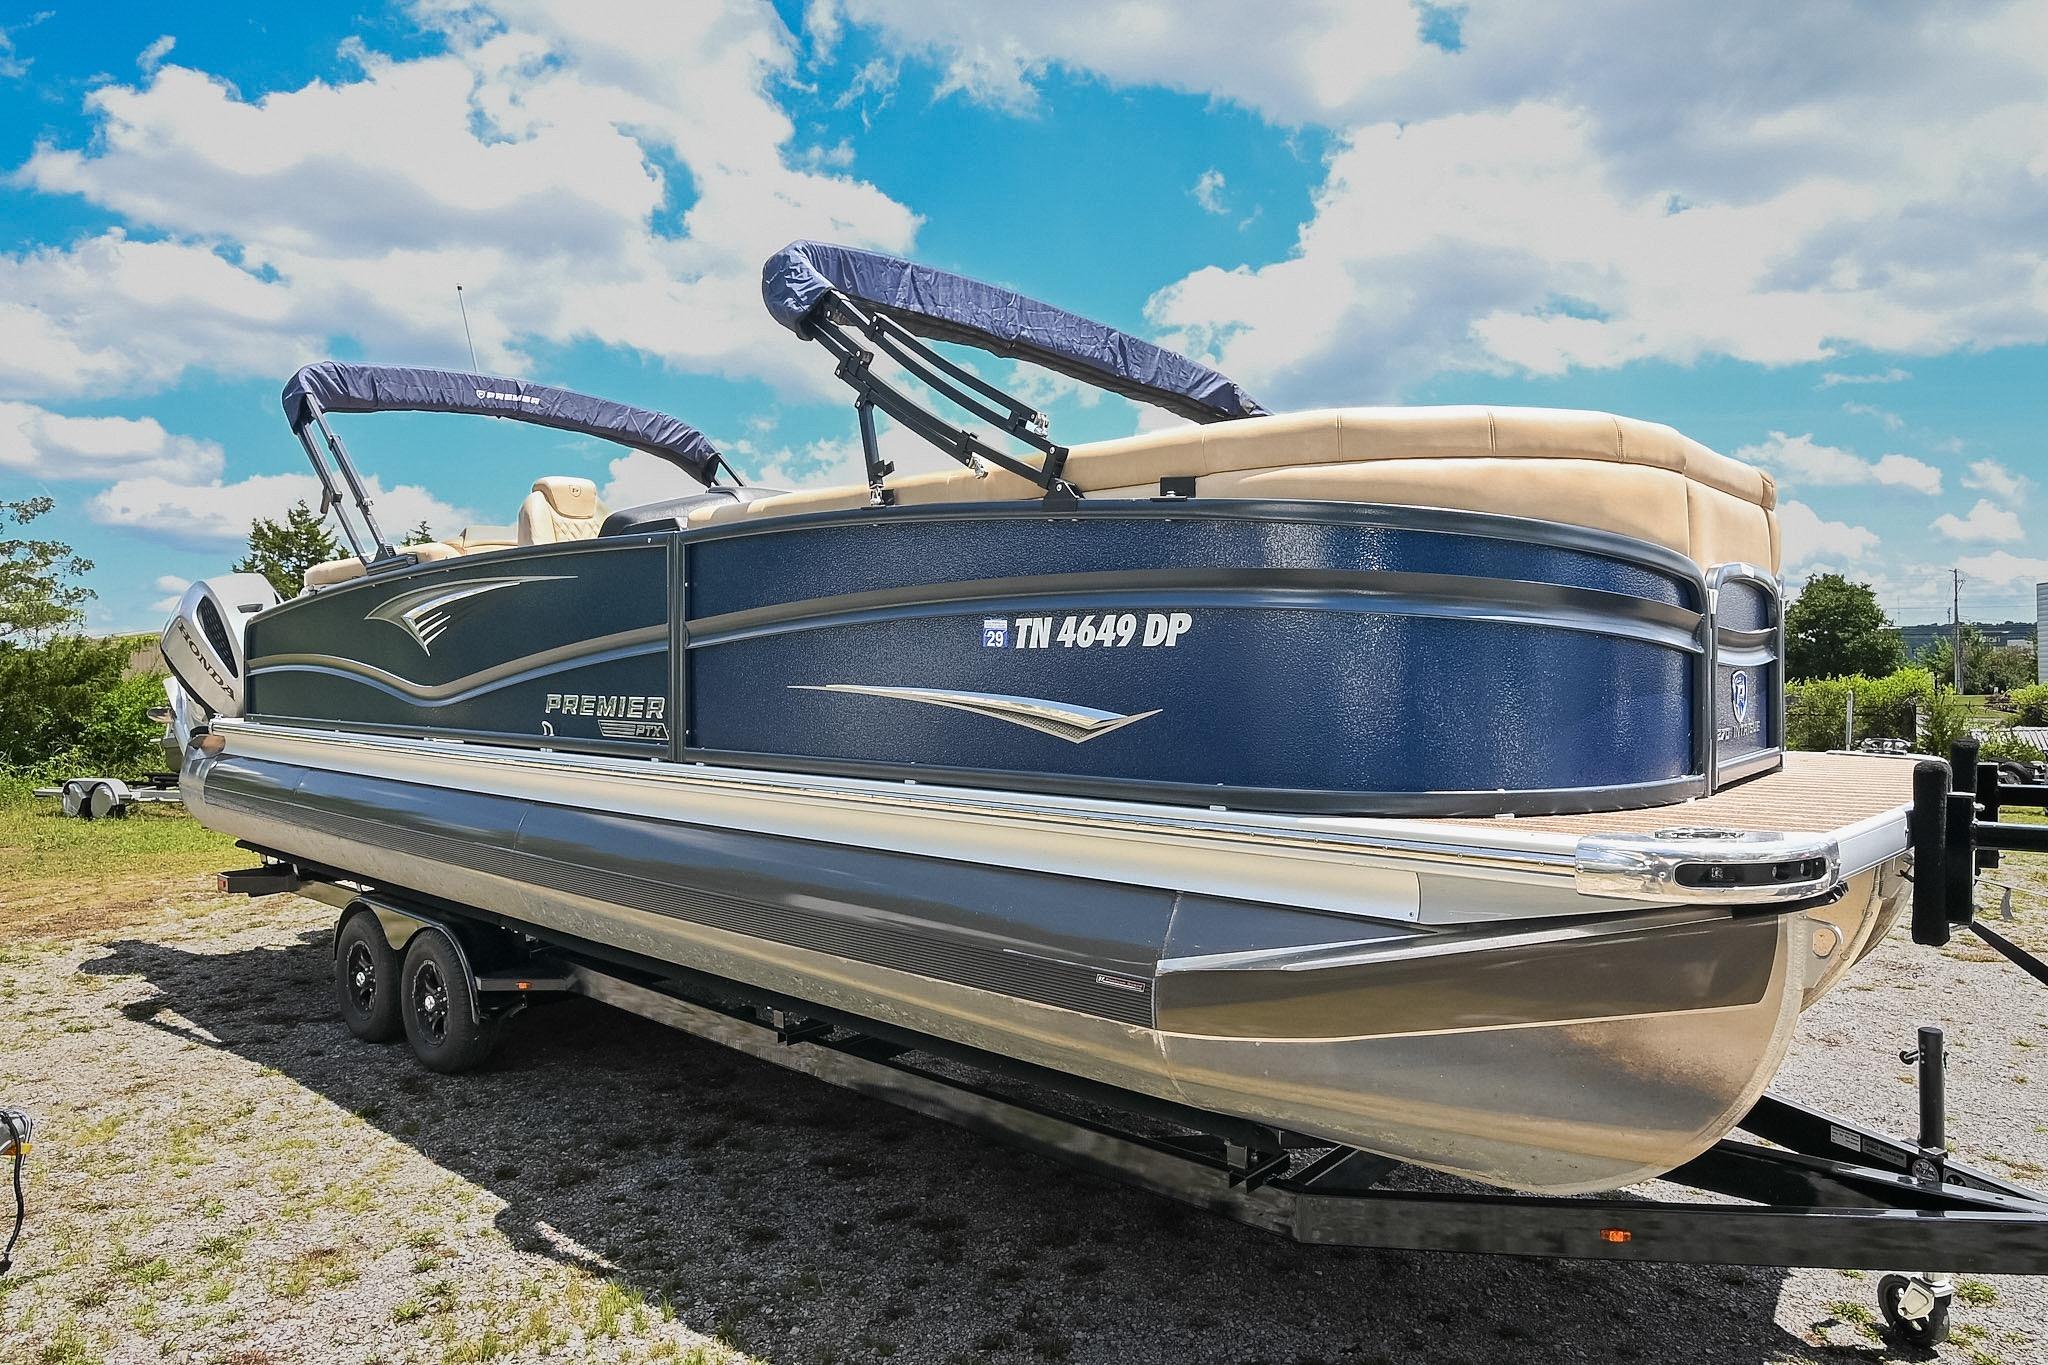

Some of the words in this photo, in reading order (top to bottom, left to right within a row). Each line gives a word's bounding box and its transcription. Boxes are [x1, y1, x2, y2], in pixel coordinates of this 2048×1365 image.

[987, 630, 1004, 648] 29
[1015, 617, 1053, 649] TN
[1057, 614, 1137, 648] 4649
[1142, 612, 1193, 647] DP
[178, 621, 236, 702] HONDA
[545, 693, 665, 719] PREMIER
[635, 724, 662, 737] PTX
